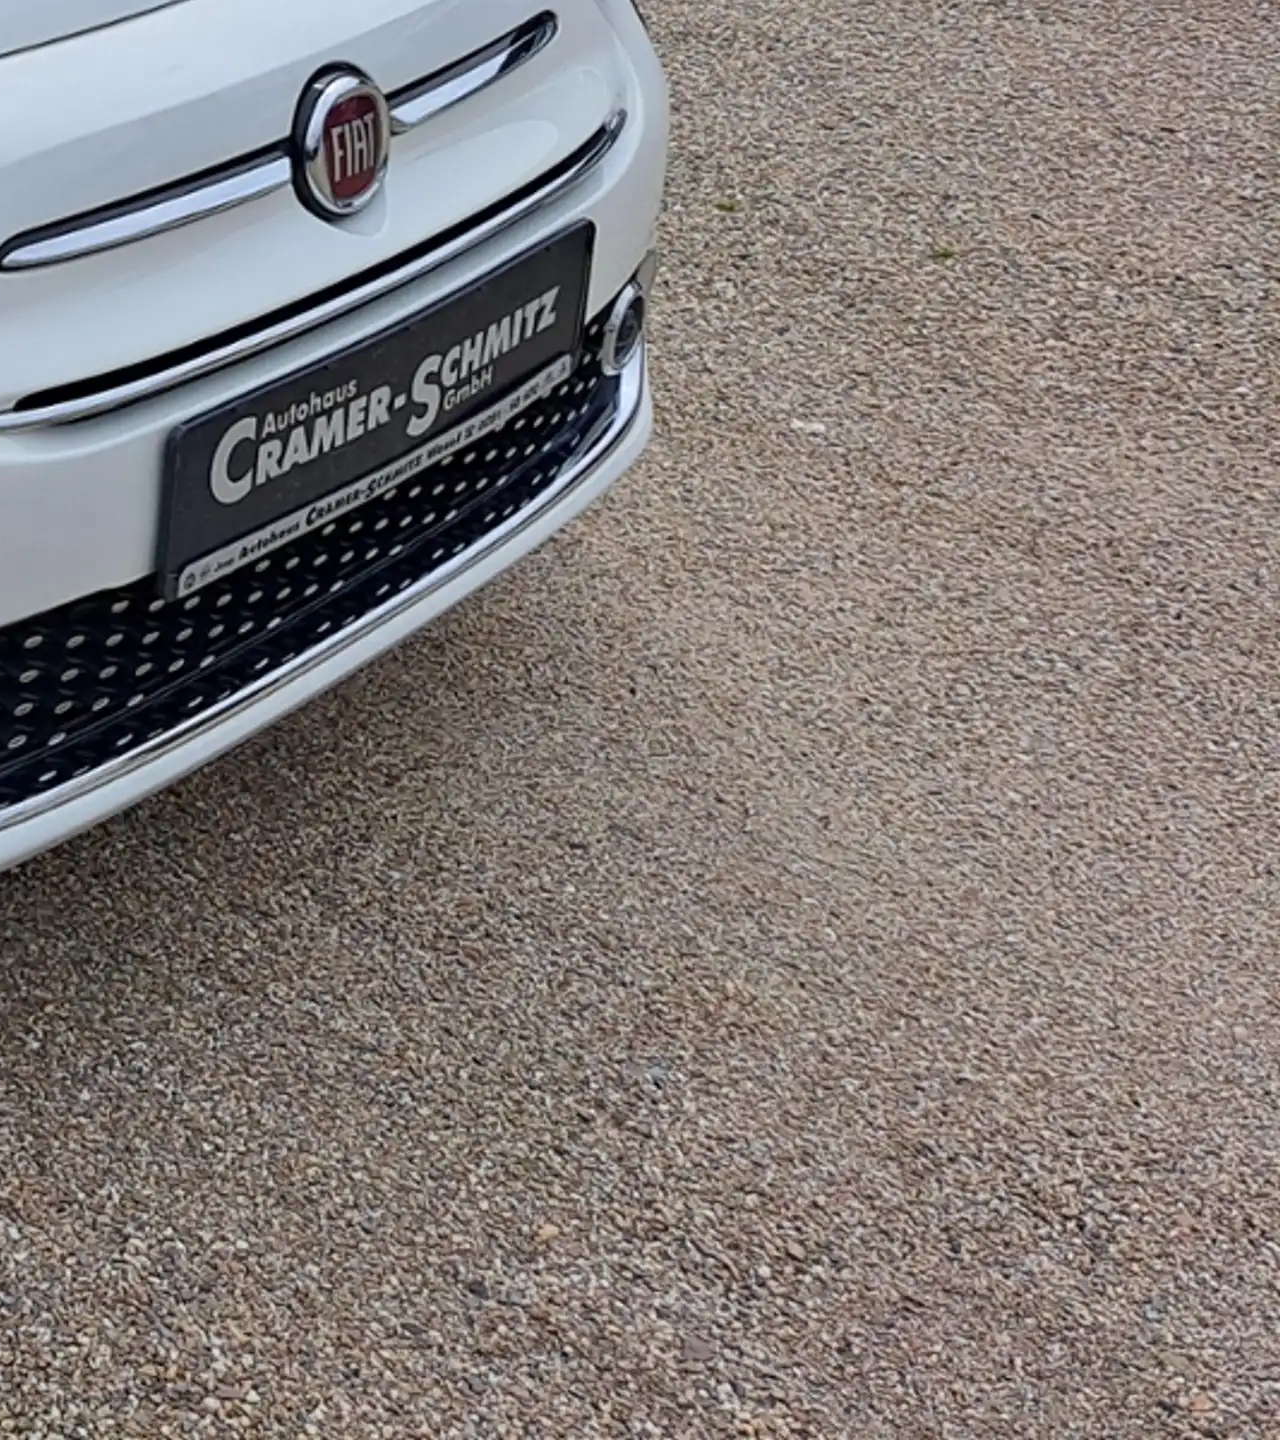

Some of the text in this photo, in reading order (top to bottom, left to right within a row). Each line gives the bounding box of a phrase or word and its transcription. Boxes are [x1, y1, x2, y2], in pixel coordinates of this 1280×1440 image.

[330, 111, 375, 183] FIAT
[261, 378, 358, 438] Autohaus
[443, 364, 494, 411] GmbH
